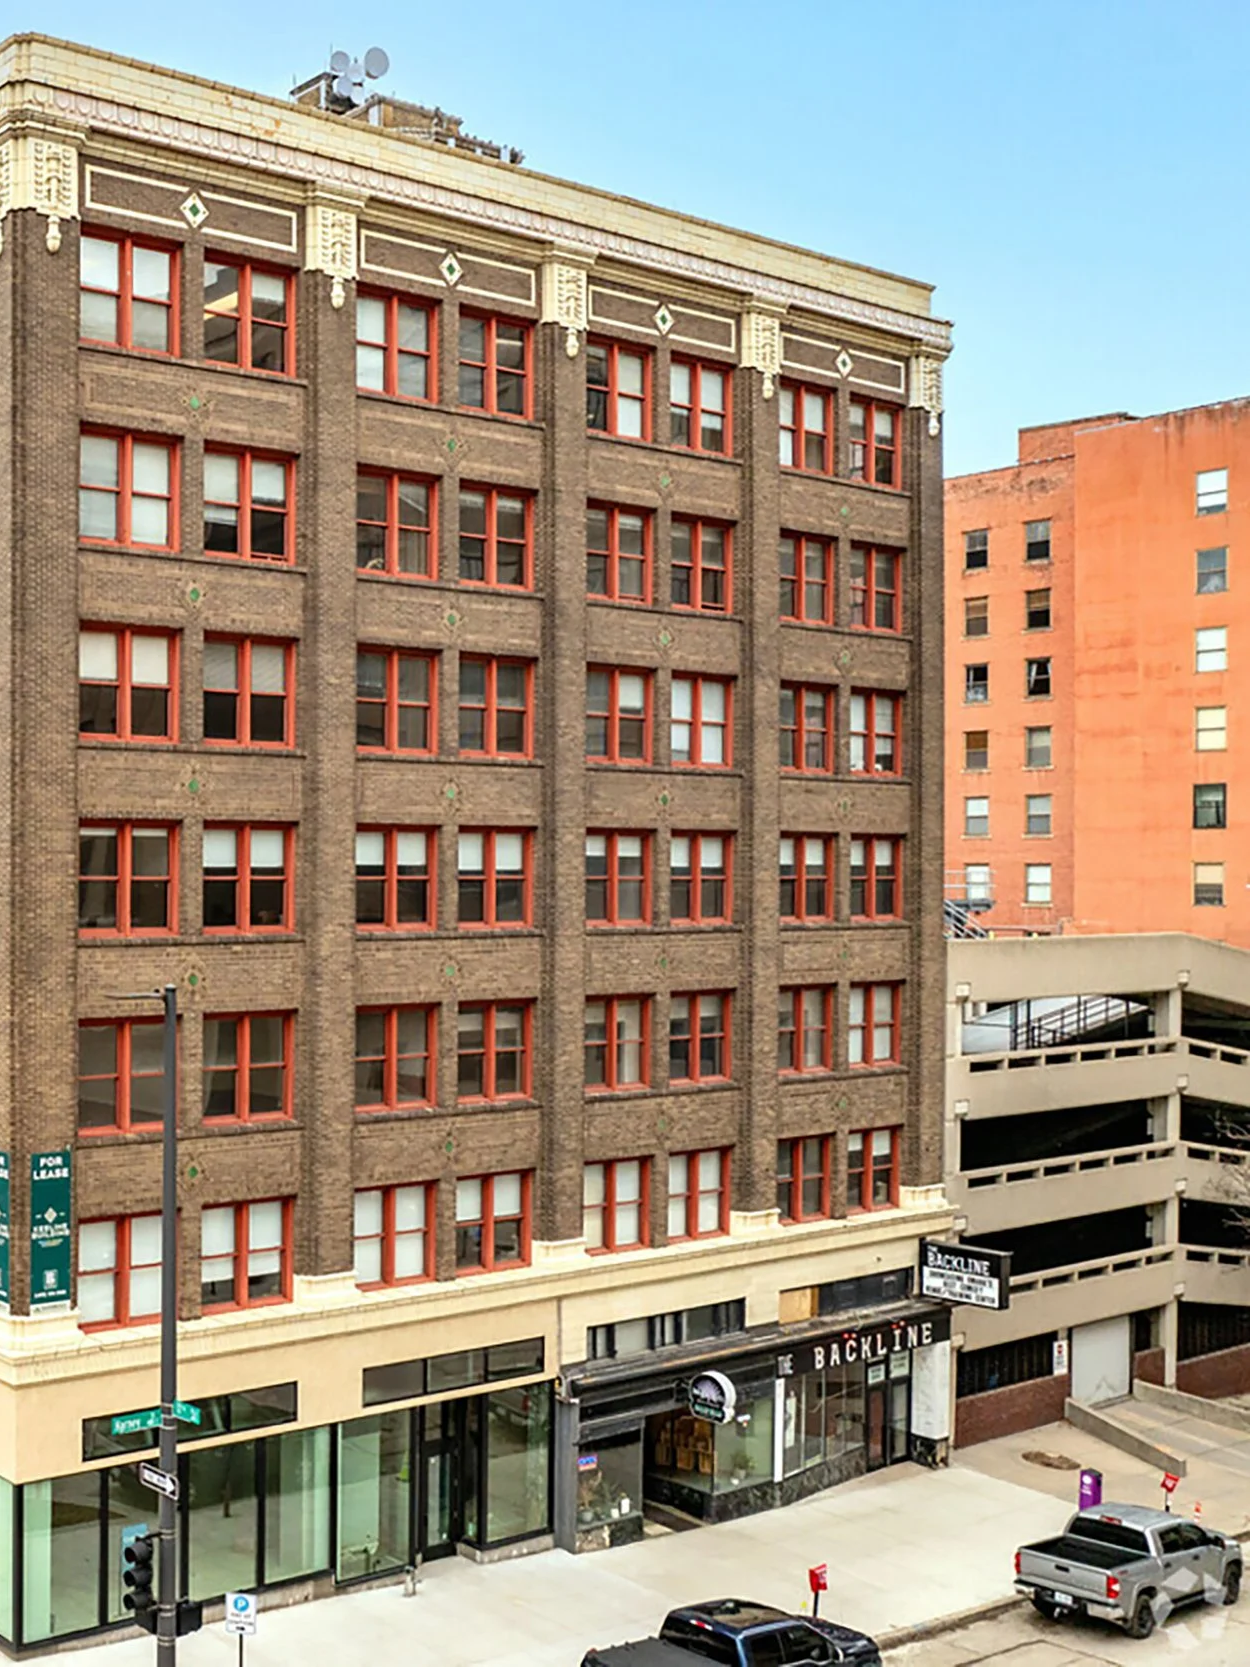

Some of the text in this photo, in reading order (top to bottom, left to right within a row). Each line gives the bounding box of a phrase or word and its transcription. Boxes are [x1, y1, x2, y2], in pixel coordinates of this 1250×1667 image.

[39, 1156, 63, 1168] FOR
[33, 1168, 69, 1181] LEASE
[927, 1251, 990, 1276] BACKLINE
[814, 1322, 932, 1370] BACKLINE
